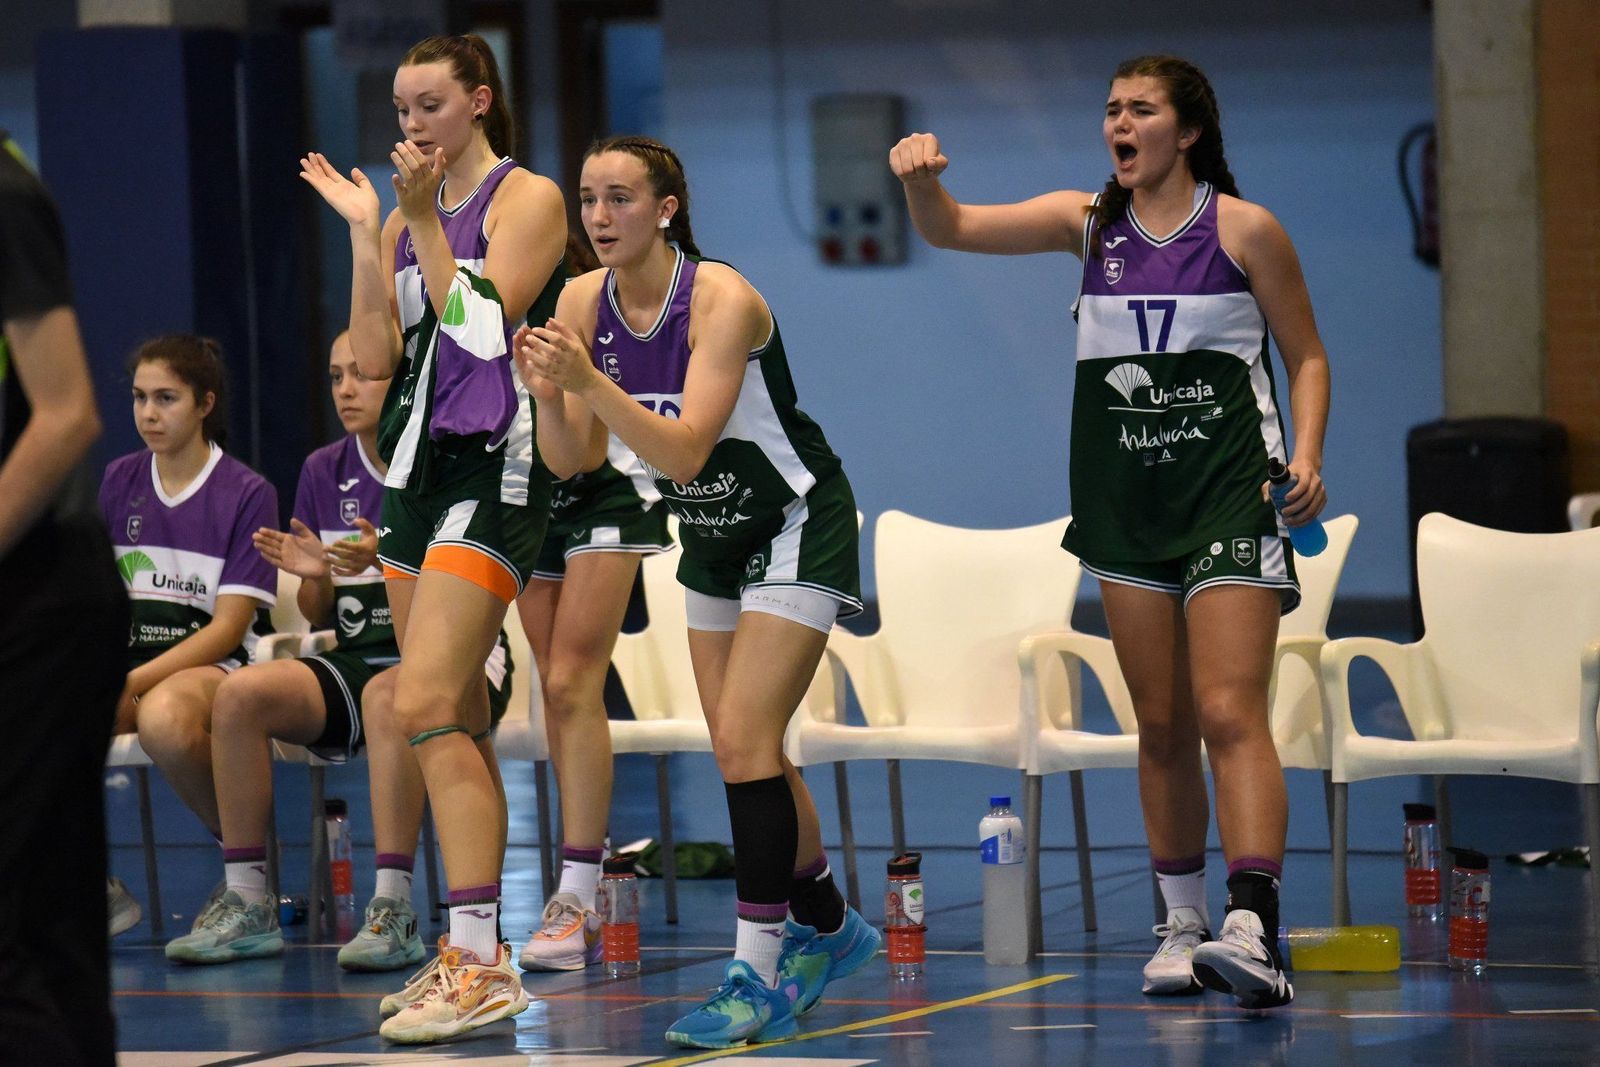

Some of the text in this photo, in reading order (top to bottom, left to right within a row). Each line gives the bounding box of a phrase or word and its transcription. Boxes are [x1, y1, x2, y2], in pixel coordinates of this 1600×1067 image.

[1128, 299, 1178, 352] 17
[1150, 379, 1215, 404] Unicaja
[672, 472, 736, 496] Unicaja
[152, 573, 207, 595] Unicaja
[371, 608, 391, 617] COST
[140, 625, 169, 635] COSTA
